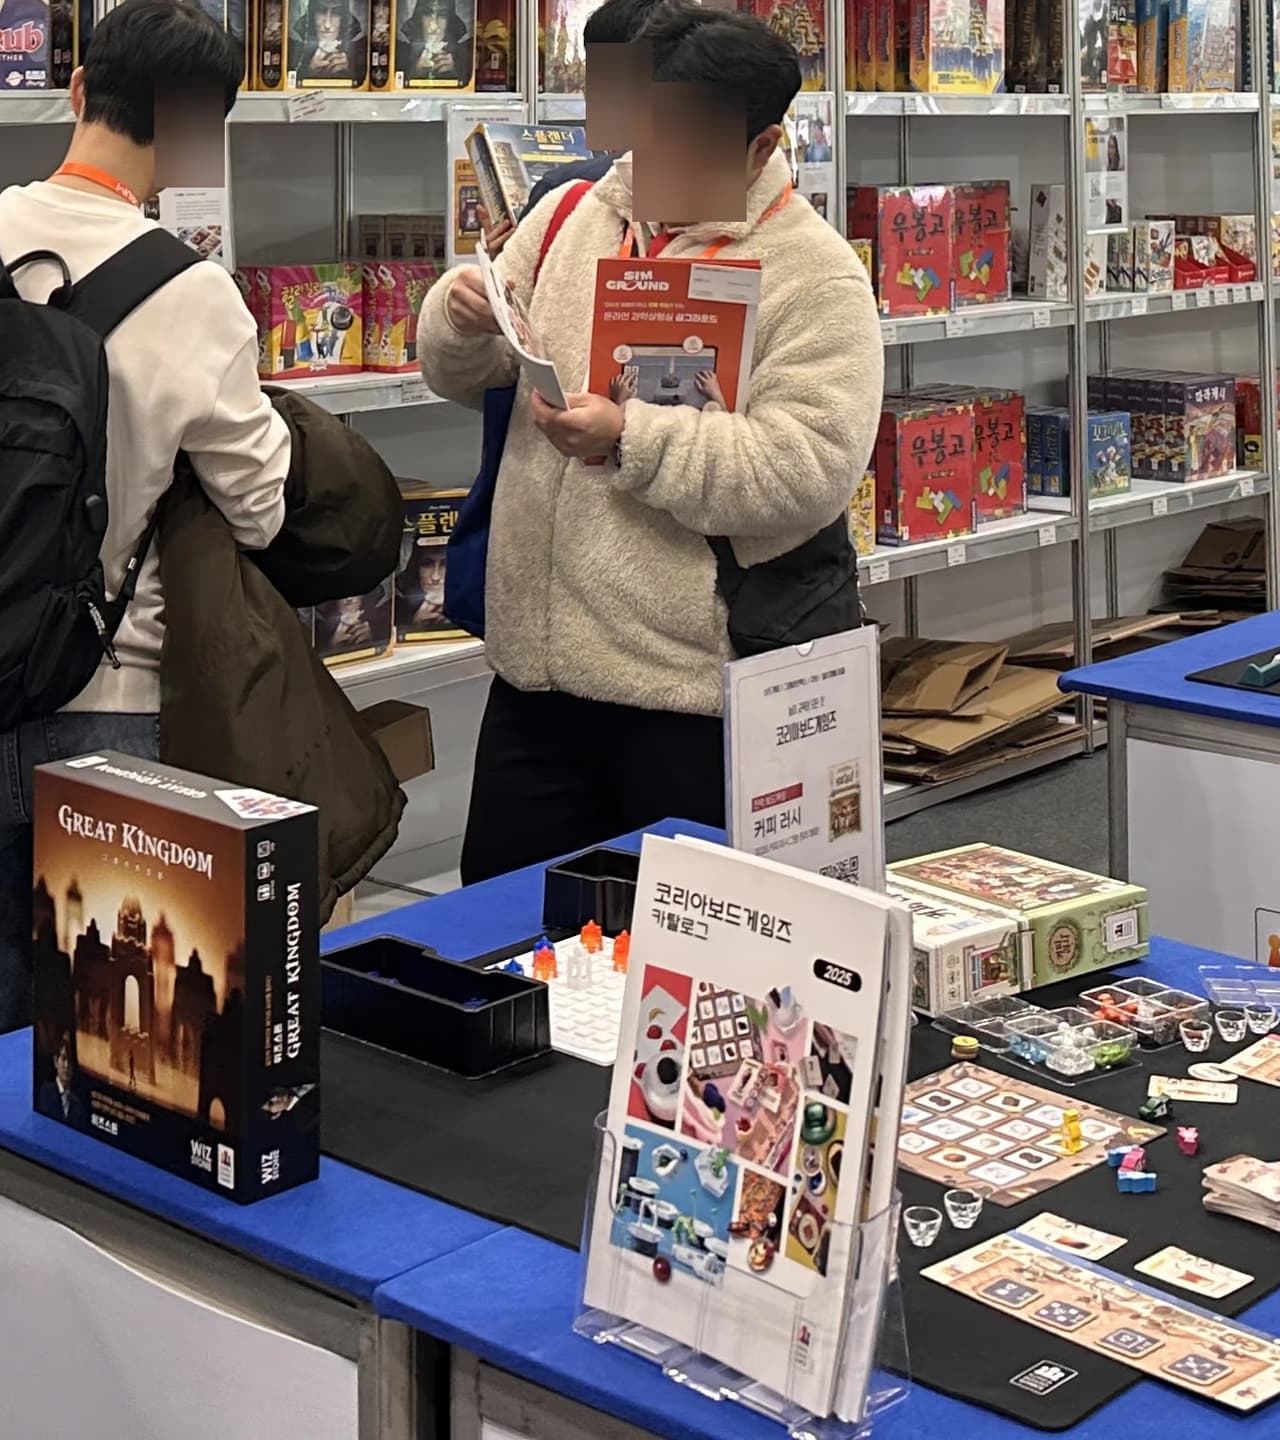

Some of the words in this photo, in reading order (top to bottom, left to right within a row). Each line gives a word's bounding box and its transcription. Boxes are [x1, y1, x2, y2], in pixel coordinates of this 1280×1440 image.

[891, 211, 946, 243] 우봉고
[623, 270, 654, 281] SIM
[909, 429, 966, 465] 우봉고
[776, 710, 838, 746] 코리아보드게임즈
[753, 812, 778, 839] 커피
[780, 806, 802, 828] 러시
[58, 803, 118, 844] GREAT
[120, 821, 214, 881] KINGDOM
[651, 906, 710, 942] 카탈로그
[653, 880, 794, 945] 코리아보드게임즈
[285, 881, 303, 985] KINGDOM
[823, 964, 855, 988] 2025
[286, 991, 302, 1059] GREAT
[190, 1138, 213, 1161] WIZ
[261, 1151, 274, 1185] WIZ
